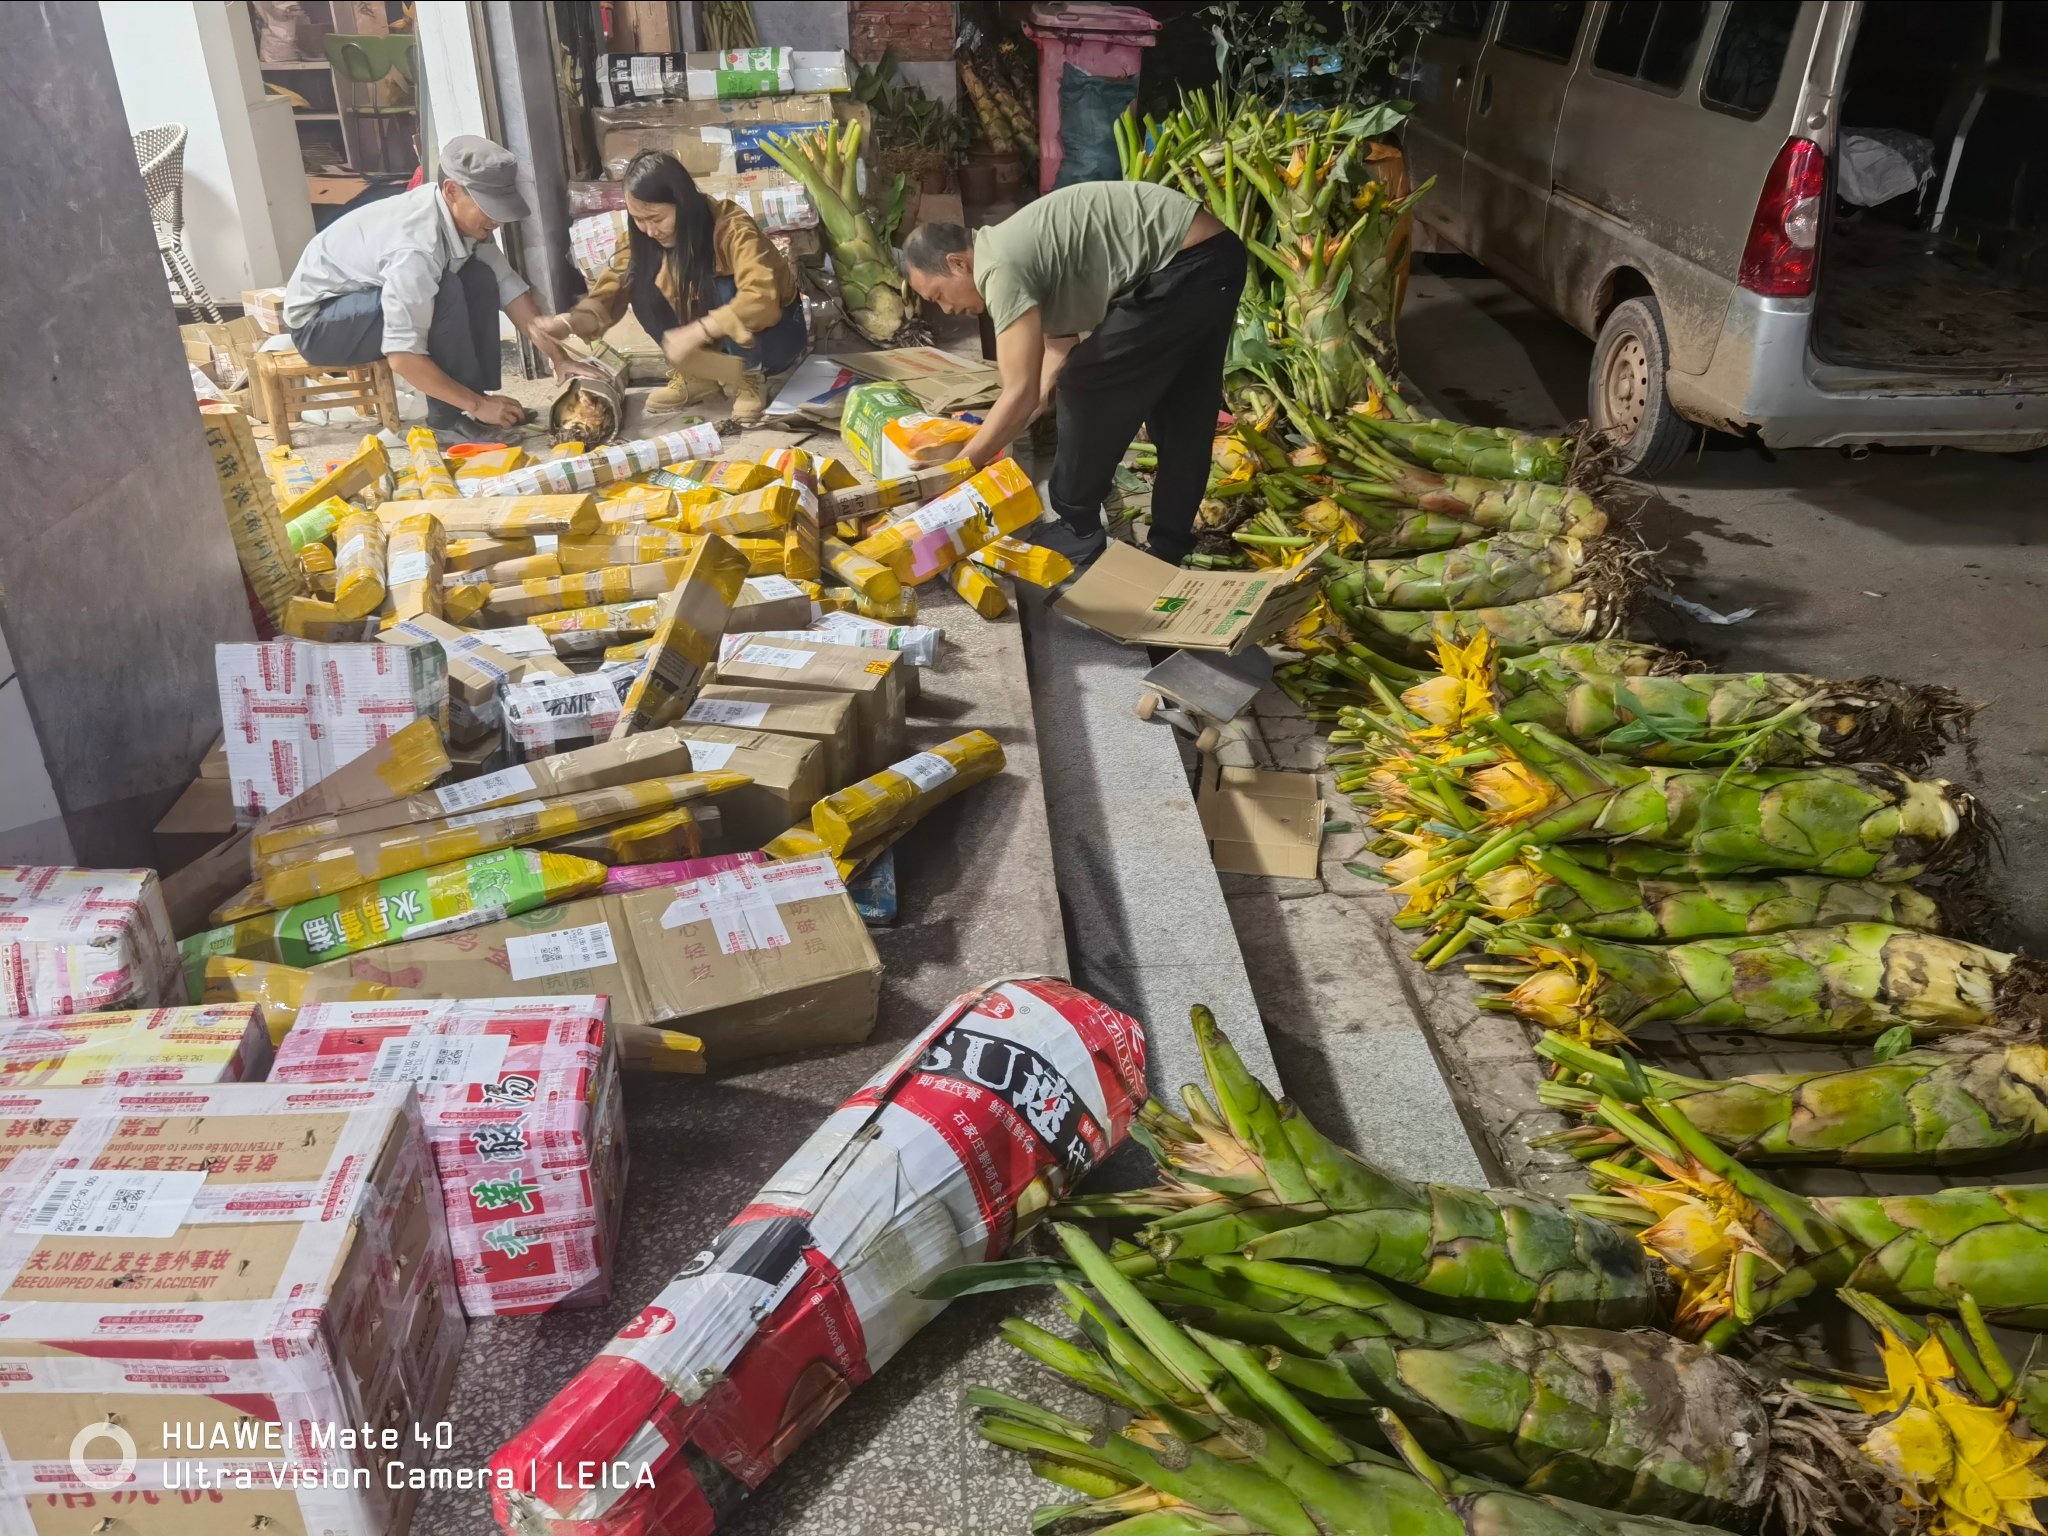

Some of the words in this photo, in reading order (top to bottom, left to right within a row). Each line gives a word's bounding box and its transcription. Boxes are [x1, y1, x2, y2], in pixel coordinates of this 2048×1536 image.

[302, 889, 424, 953] 水晶葡萄
[788, 902, 828, 956] 防破损
[916, 1074, 983, 1103] 即食代餐
[987, 1098, 1037, 1155] 鲜道鲜得
[107, 1142, 142, 1154] engine
[144, 1142, 166, 1153] add
[167, 1142, 179, 1153] to
[181, 1143, 204, 1153] sure
[12, 1275, 94, 1290] BEEQUIPPED
[153, 1275, 219, 1290] ACCIDENT
